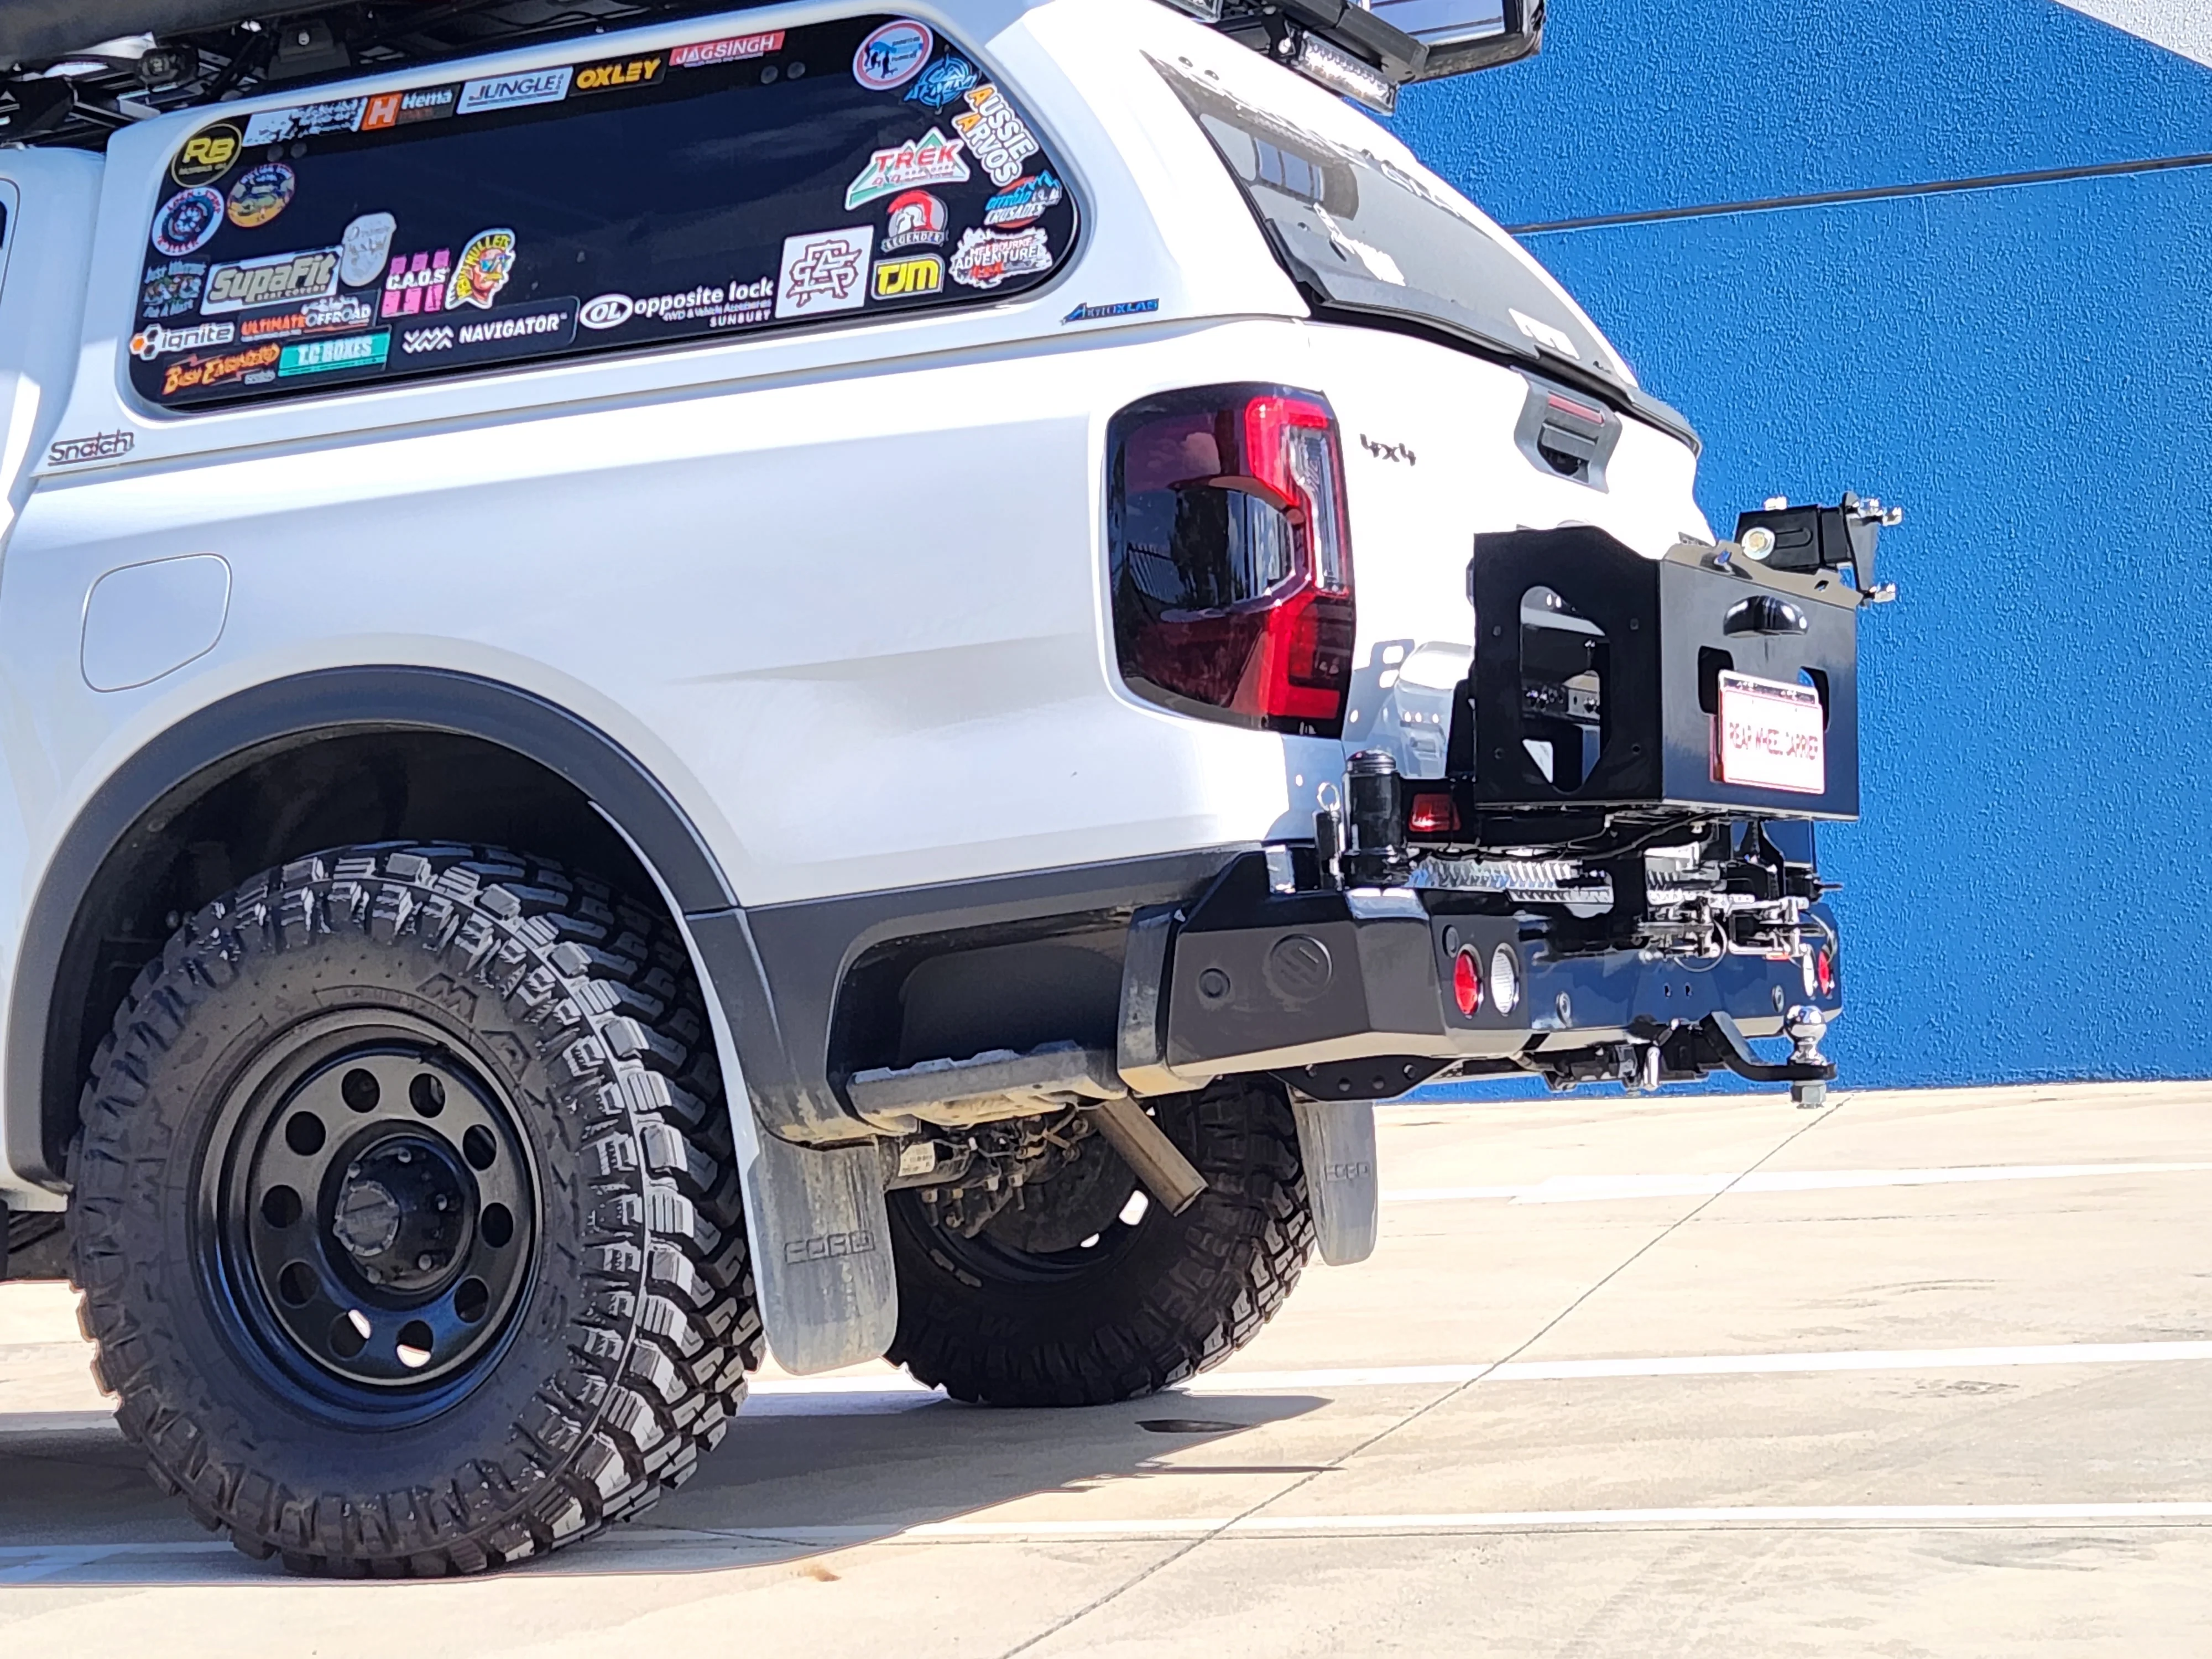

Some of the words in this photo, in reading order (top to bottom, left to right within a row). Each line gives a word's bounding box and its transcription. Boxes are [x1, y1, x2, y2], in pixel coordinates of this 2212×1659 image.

[675, 34, 774, 64] JAGSINGH
[468, 75, 555, 101] JUNGLE
[576, 58, 661, 90] OXLEY
[400, 88, 453, 110] Hema
[968, 86, 1036, 160] AUSSIE
[182, 137, 236, 165] RB
[875, 144, 957, 172] TREK
[955, 113, 1019, 183] ARVOS
[209, 253, 337, 302] SupaFit
[878, 259, 939, 296] TJM
[589, 301, 623, 322] OL
[634, 284, 724, 319] opposite
[728, 276, 774, 301] lock
[241, 314, 305, 336] ULTIMATE
[305, 302, 372, 327] OFFROAD
[458, 313, 560, 344] NAVIGATOR
[709, 309, 771, 327] SUNBURY
[161, 325, 231, 349] ignite
[321, 335, 373, 363] BOXES
[48, 427, 134, 463] Snatch
[783, 1229, 876, 1265] FORD
